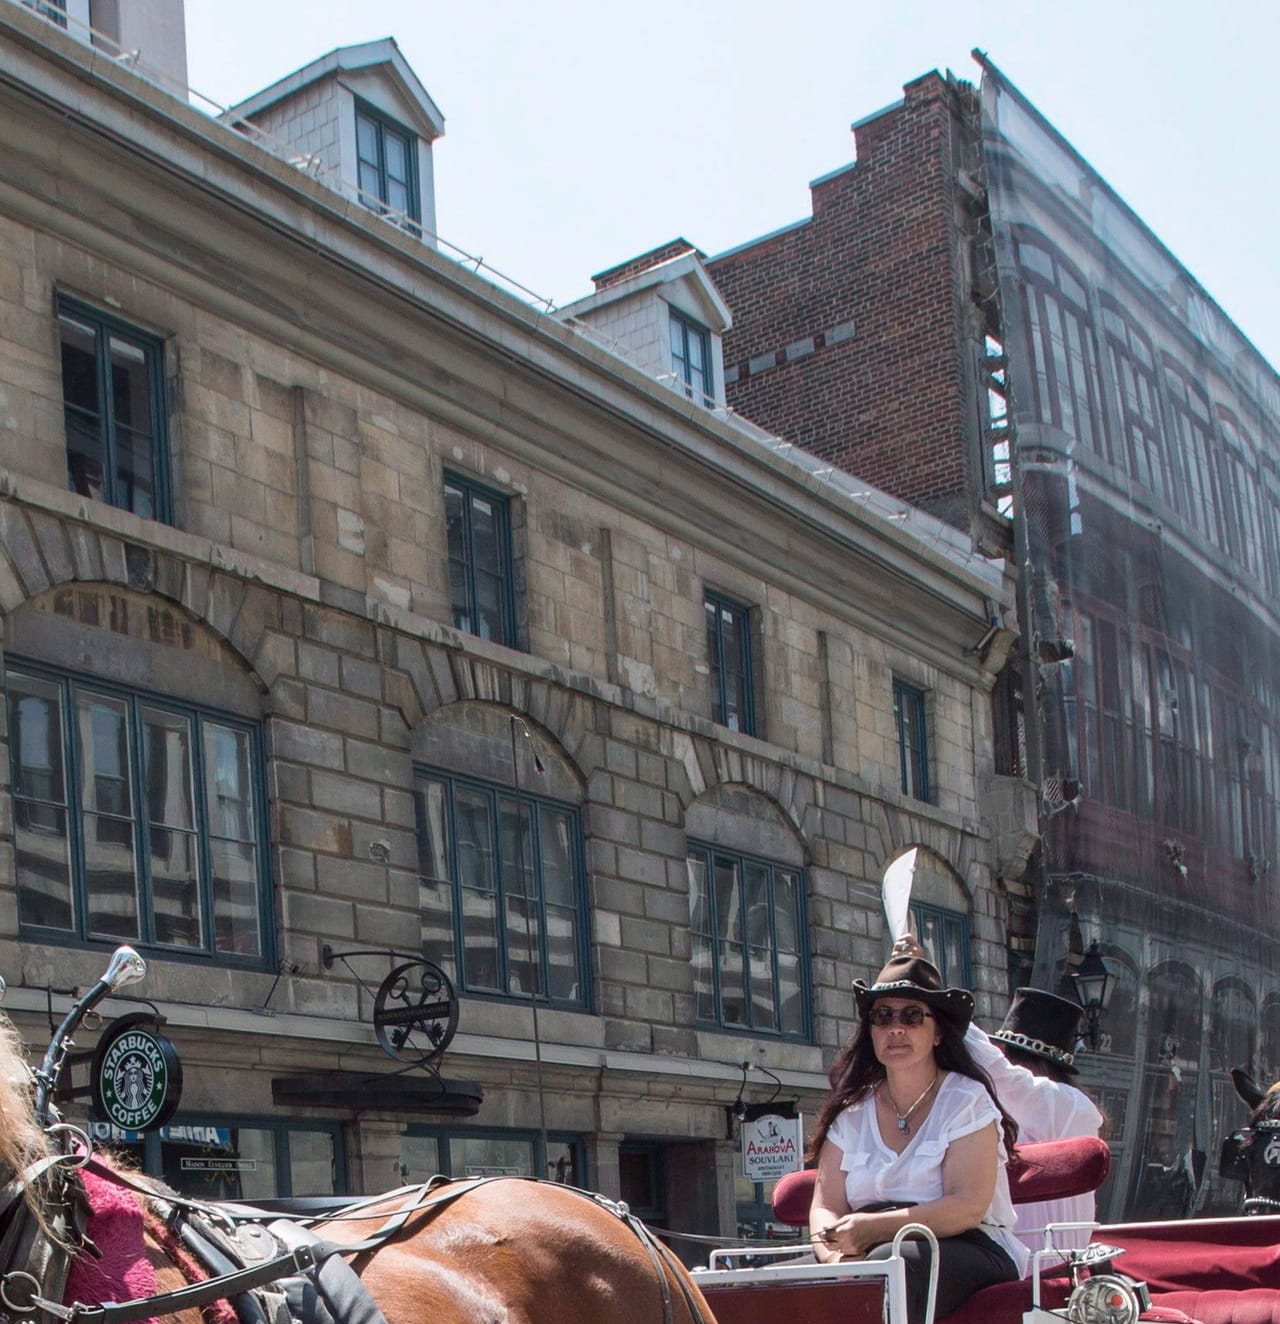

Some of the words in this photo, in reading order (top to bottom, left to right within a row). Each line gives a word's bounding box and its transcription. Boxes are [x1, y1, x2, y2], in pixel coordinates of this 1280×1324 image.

[104, 1036, 163, 1080] STARBUCKS
[111, 1100, 157, 1125] COFFEE
[749, 1155, 794, 1165] SOUVLAKI
